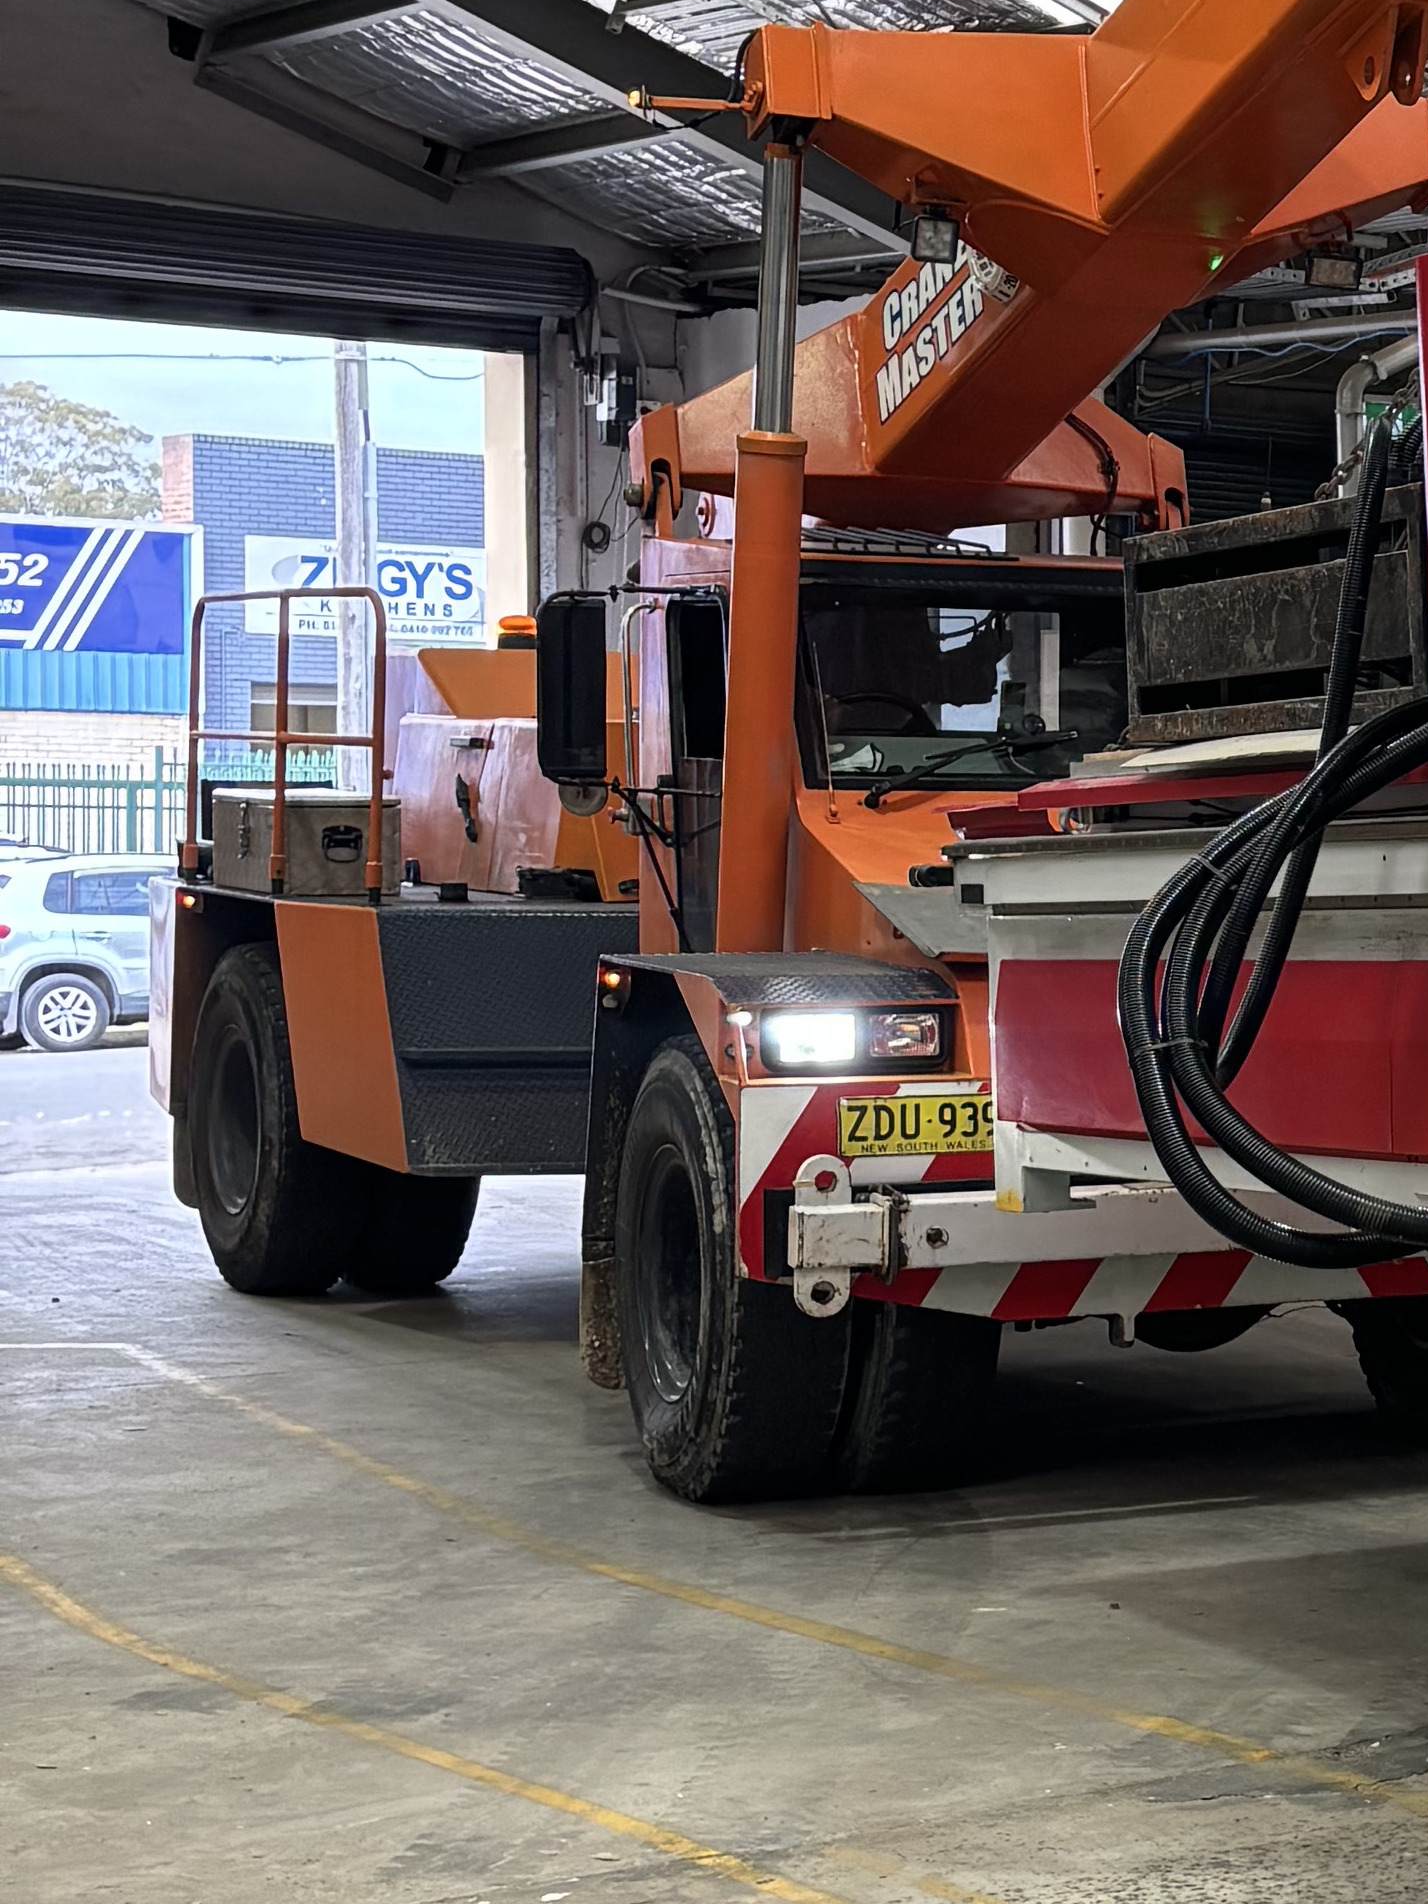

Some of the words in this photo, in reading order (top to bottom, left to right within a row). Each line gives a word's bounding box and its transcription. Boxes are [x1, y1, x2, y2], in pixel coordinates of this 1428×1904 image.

[876, 274, 984, 425] MASTER
[0, 552, 49, 586] 52
[300, 555, 473, 601] ZGY'S
[320, 599, 453, 617] KHENS
[861, 1143, 889, 1153] NEW
[896, 1142, 938, 1153] SOUTH
[945, 1140, 987, 1151] WALES
